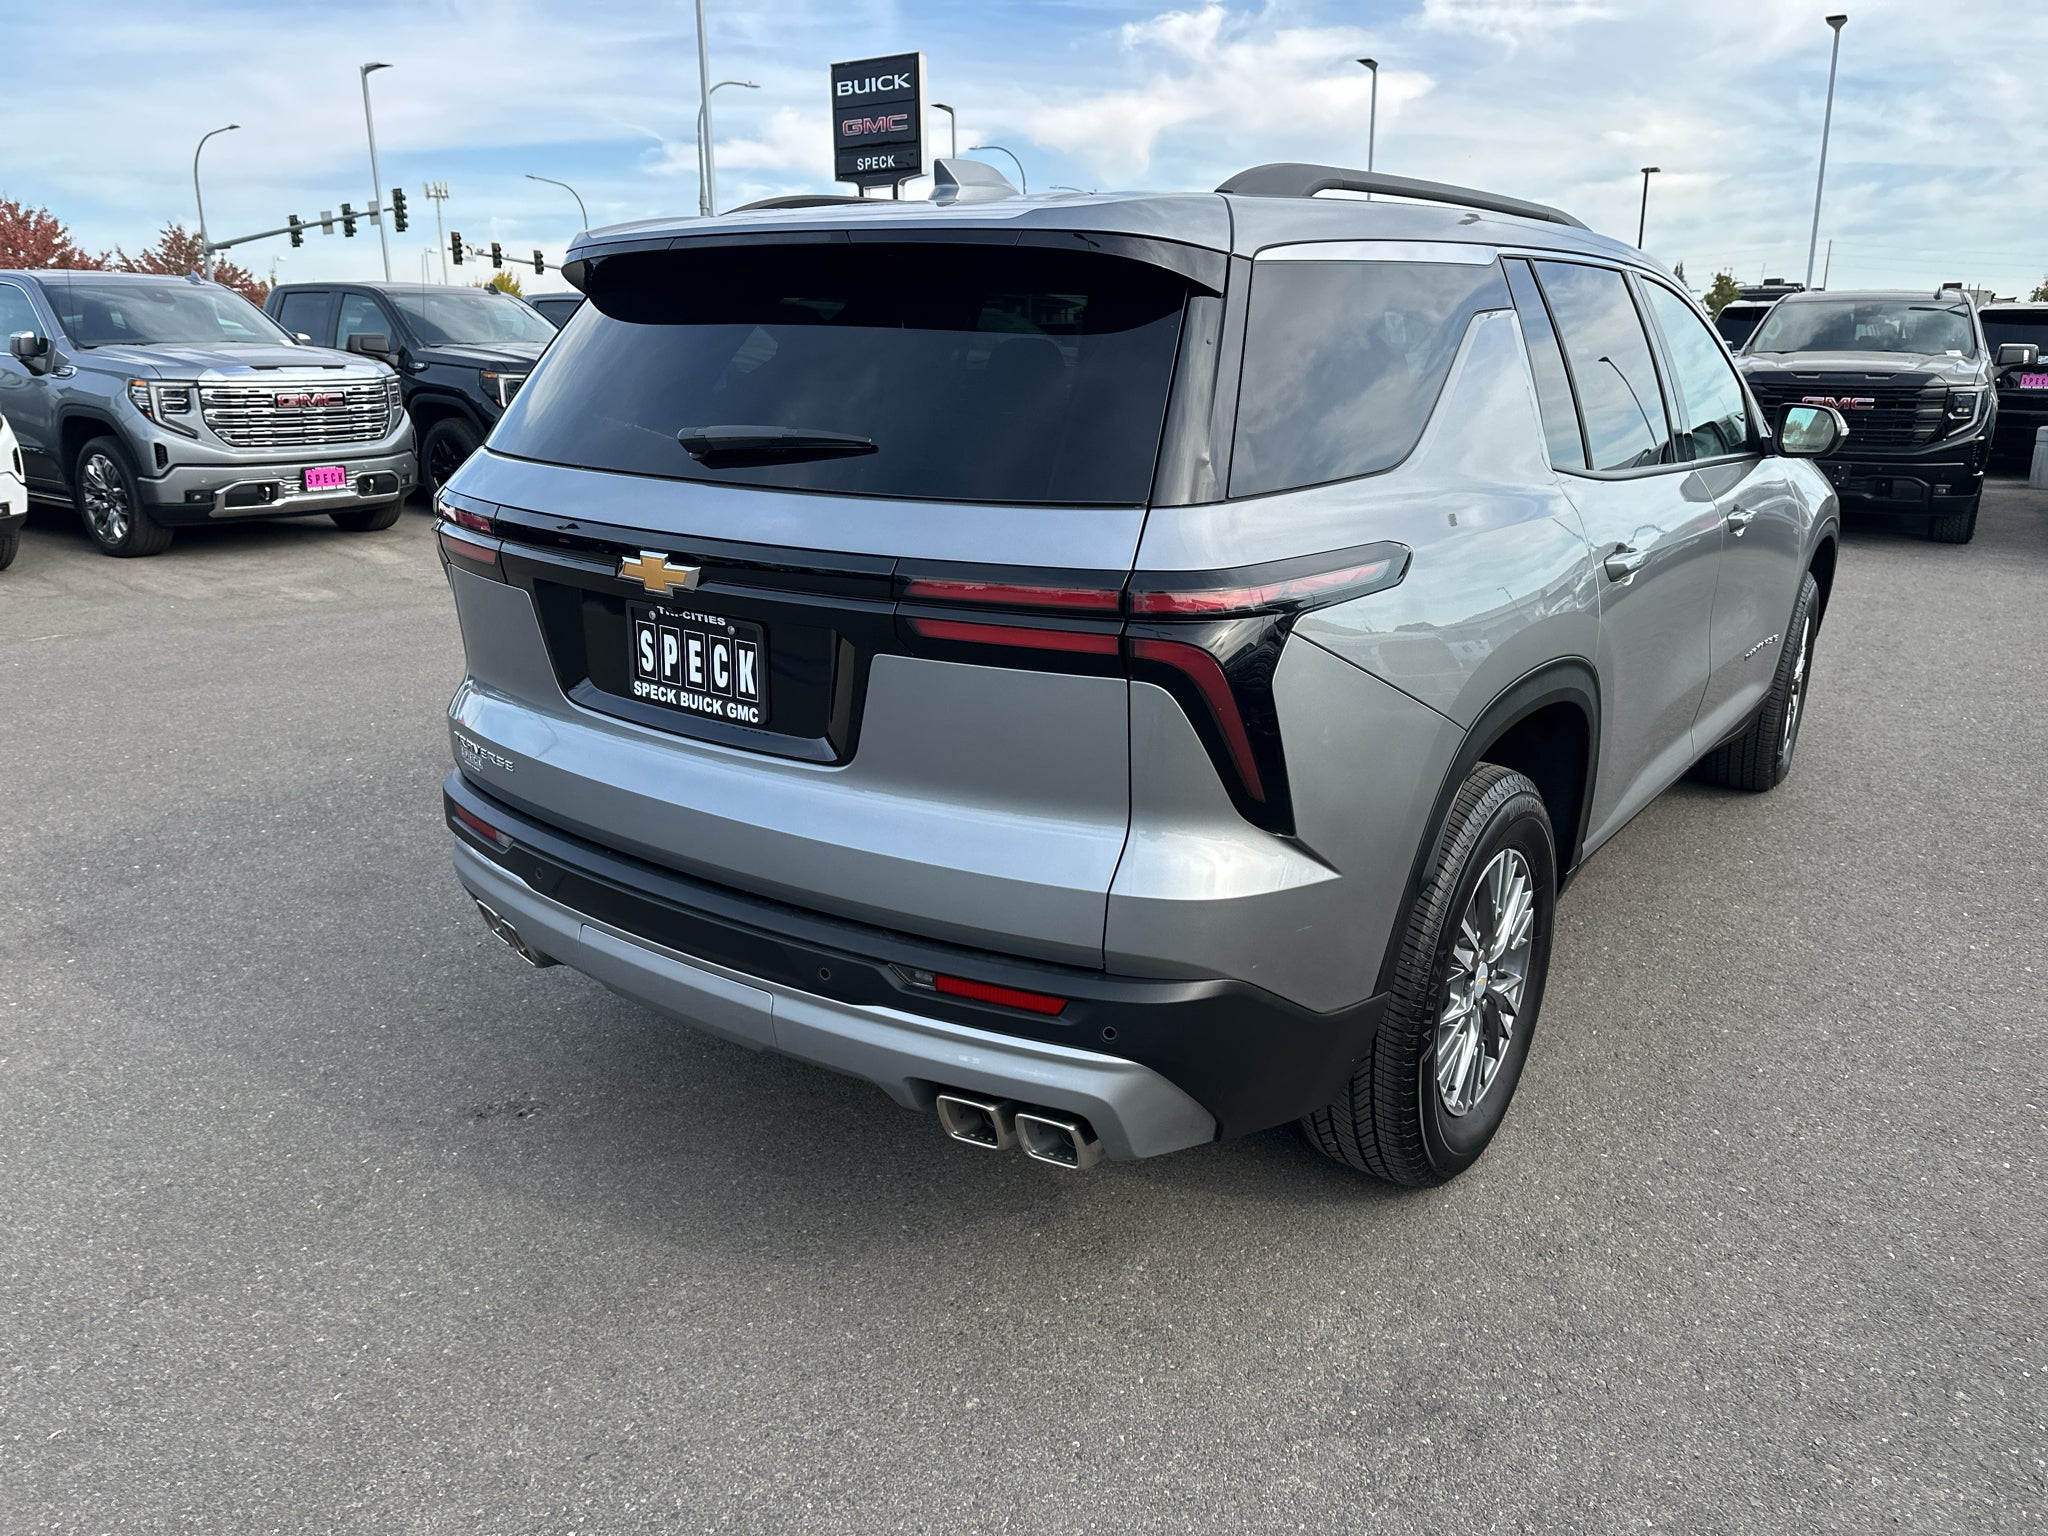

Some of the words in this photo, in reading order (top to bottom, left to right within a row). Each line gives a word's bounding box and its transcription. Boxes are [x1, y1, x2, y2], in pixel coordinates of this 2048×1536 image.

[836, 73, 911, 97] BUICK
[842, 114, 908, 137] GMC
[857, 155, 895, 171] SPECK
[2023, 377, 2048, 385] SPEC
[277, 393, 344, 408] GMC
[1802, 396, 1875, 410] GMC
[307, 473, 343, 485] SPECK
[640, 629, 756, 694] SPECK
[633, 680, 677, 705] SPECK
[680, 691, 723, 716] BUICK
[726, 704, 759, 724] GMC
